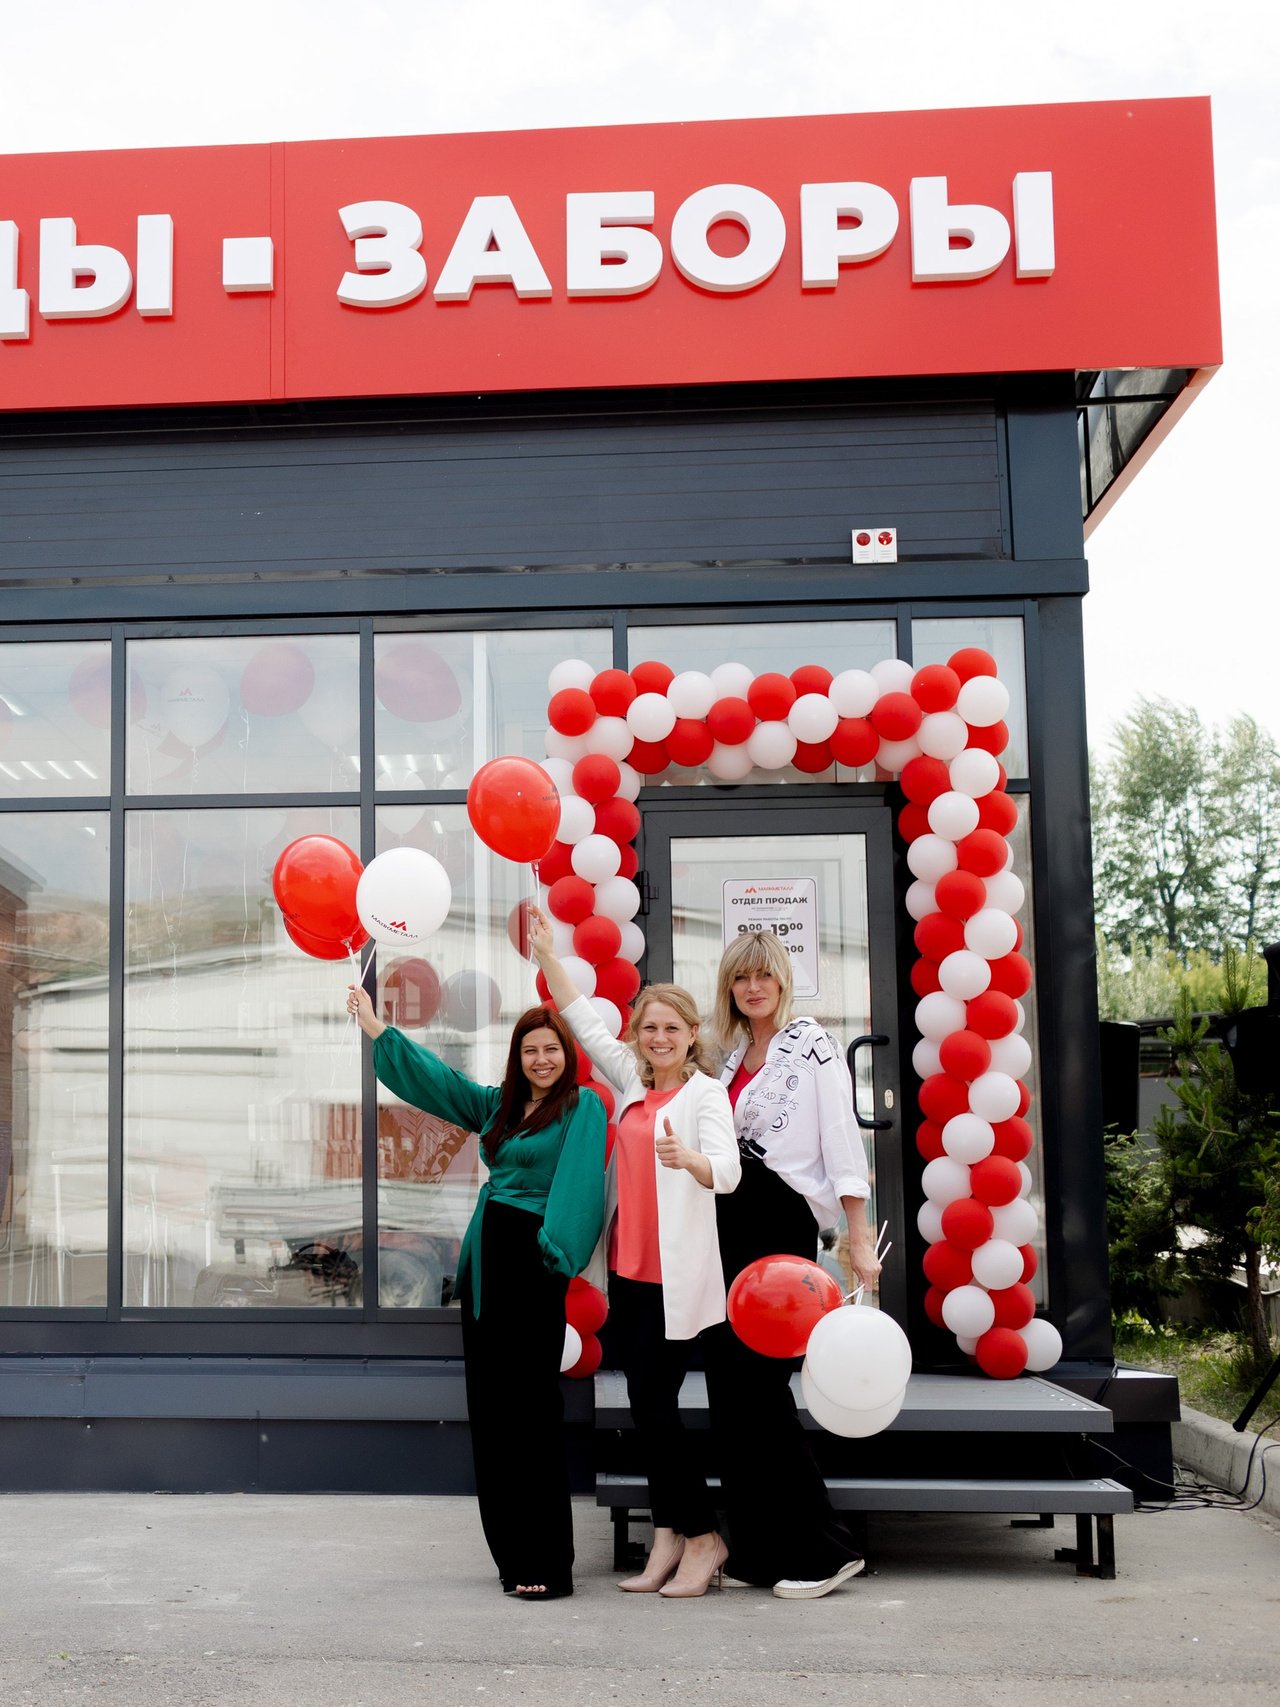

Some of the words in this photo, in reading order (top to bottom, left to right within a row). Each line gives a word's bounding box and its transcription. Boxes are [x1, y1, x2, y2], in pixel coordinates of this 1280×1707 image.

[336, 171, 1056, 308] ЗАБОРЫ
[732, 897, 762, 905] ОТДЕЛ
[765, 896, 807, 904] ПРОДАЖ
